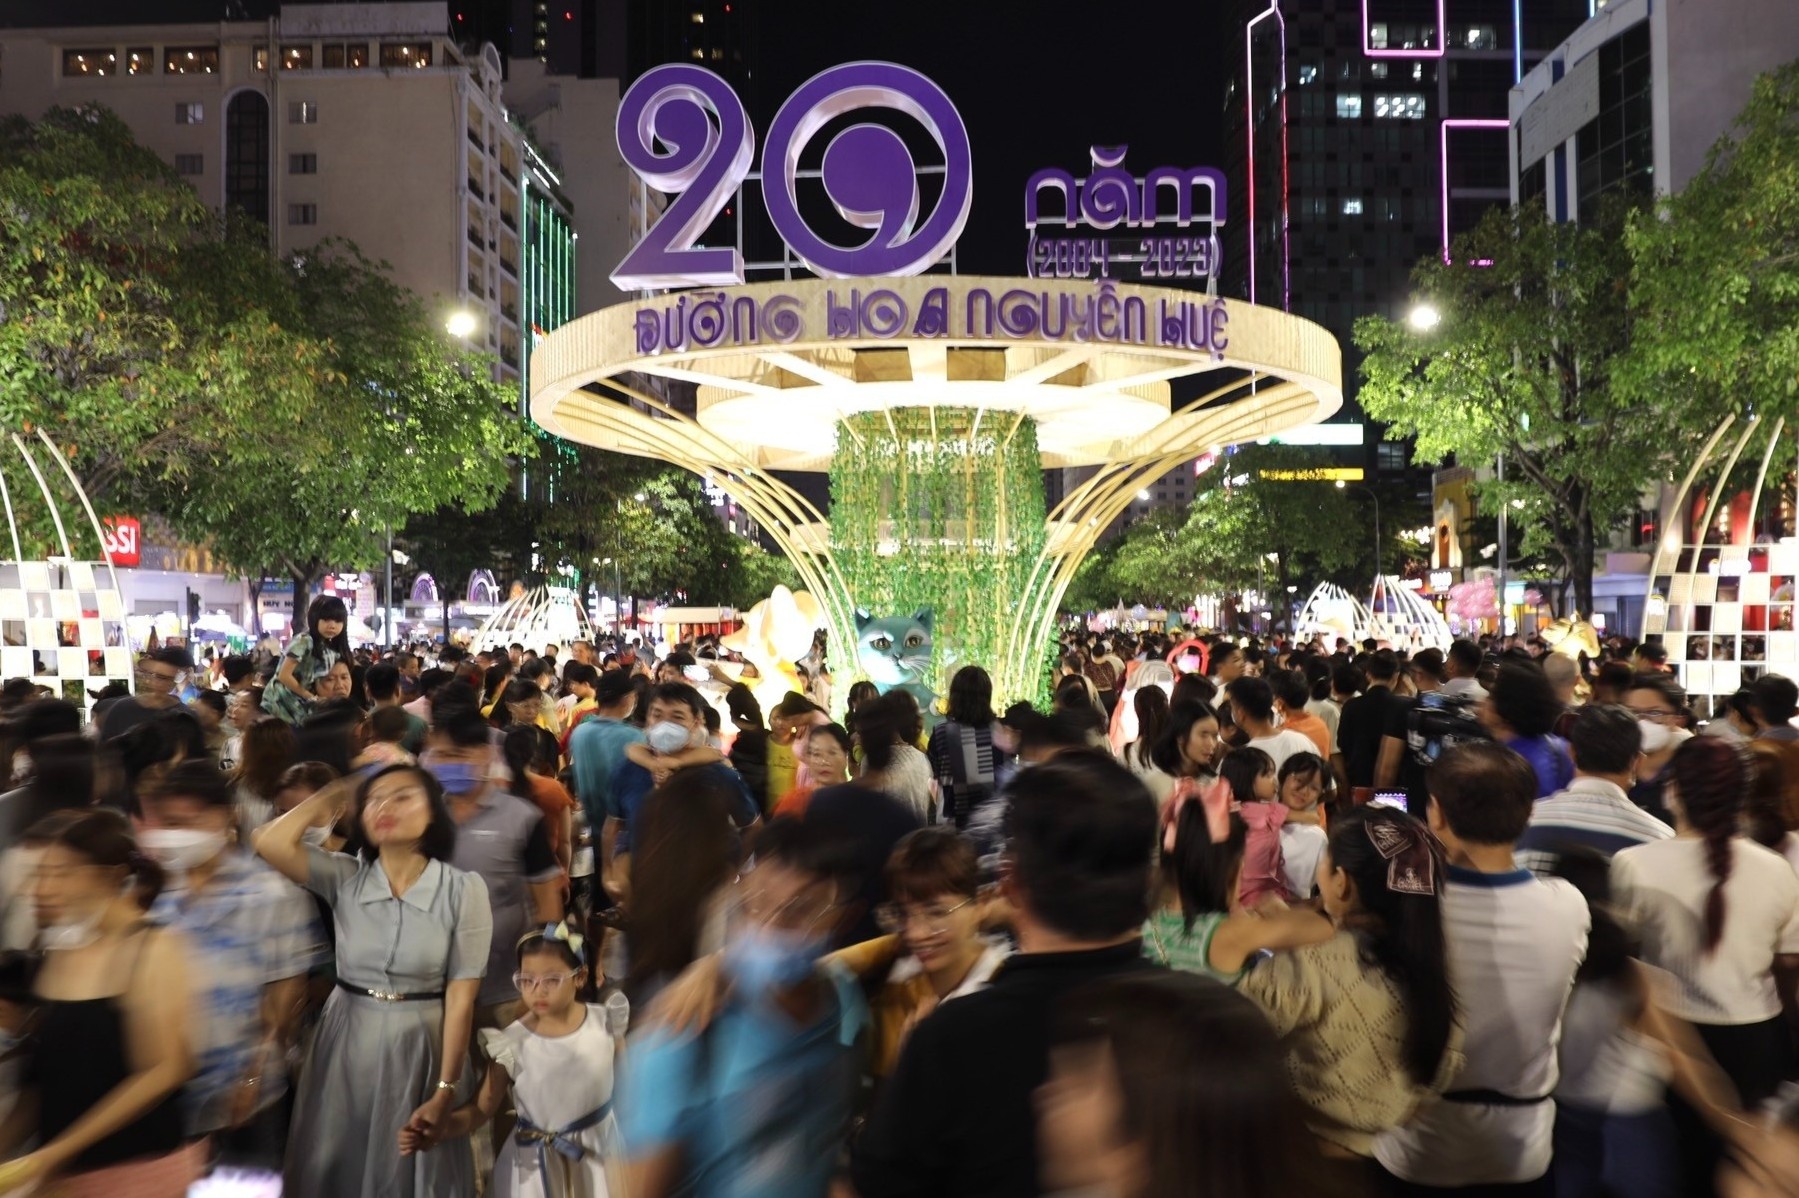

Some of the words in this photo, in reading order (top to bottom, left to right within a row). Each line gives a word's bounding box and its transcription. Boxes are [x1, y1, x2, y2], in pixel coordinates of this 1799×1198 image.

[609, 60, 972, 291] 20
[1027, 234, 1109, 278] (2004
[1140, 233, 1223, 278] 2023)
[633, 292, 807, 355] ĐƯỜNG
[827, 287, 950, 338] HOA
[966, 279, 1146, 342] NGUYỄN
[1157, 297, 1229, 361] HUỆ
